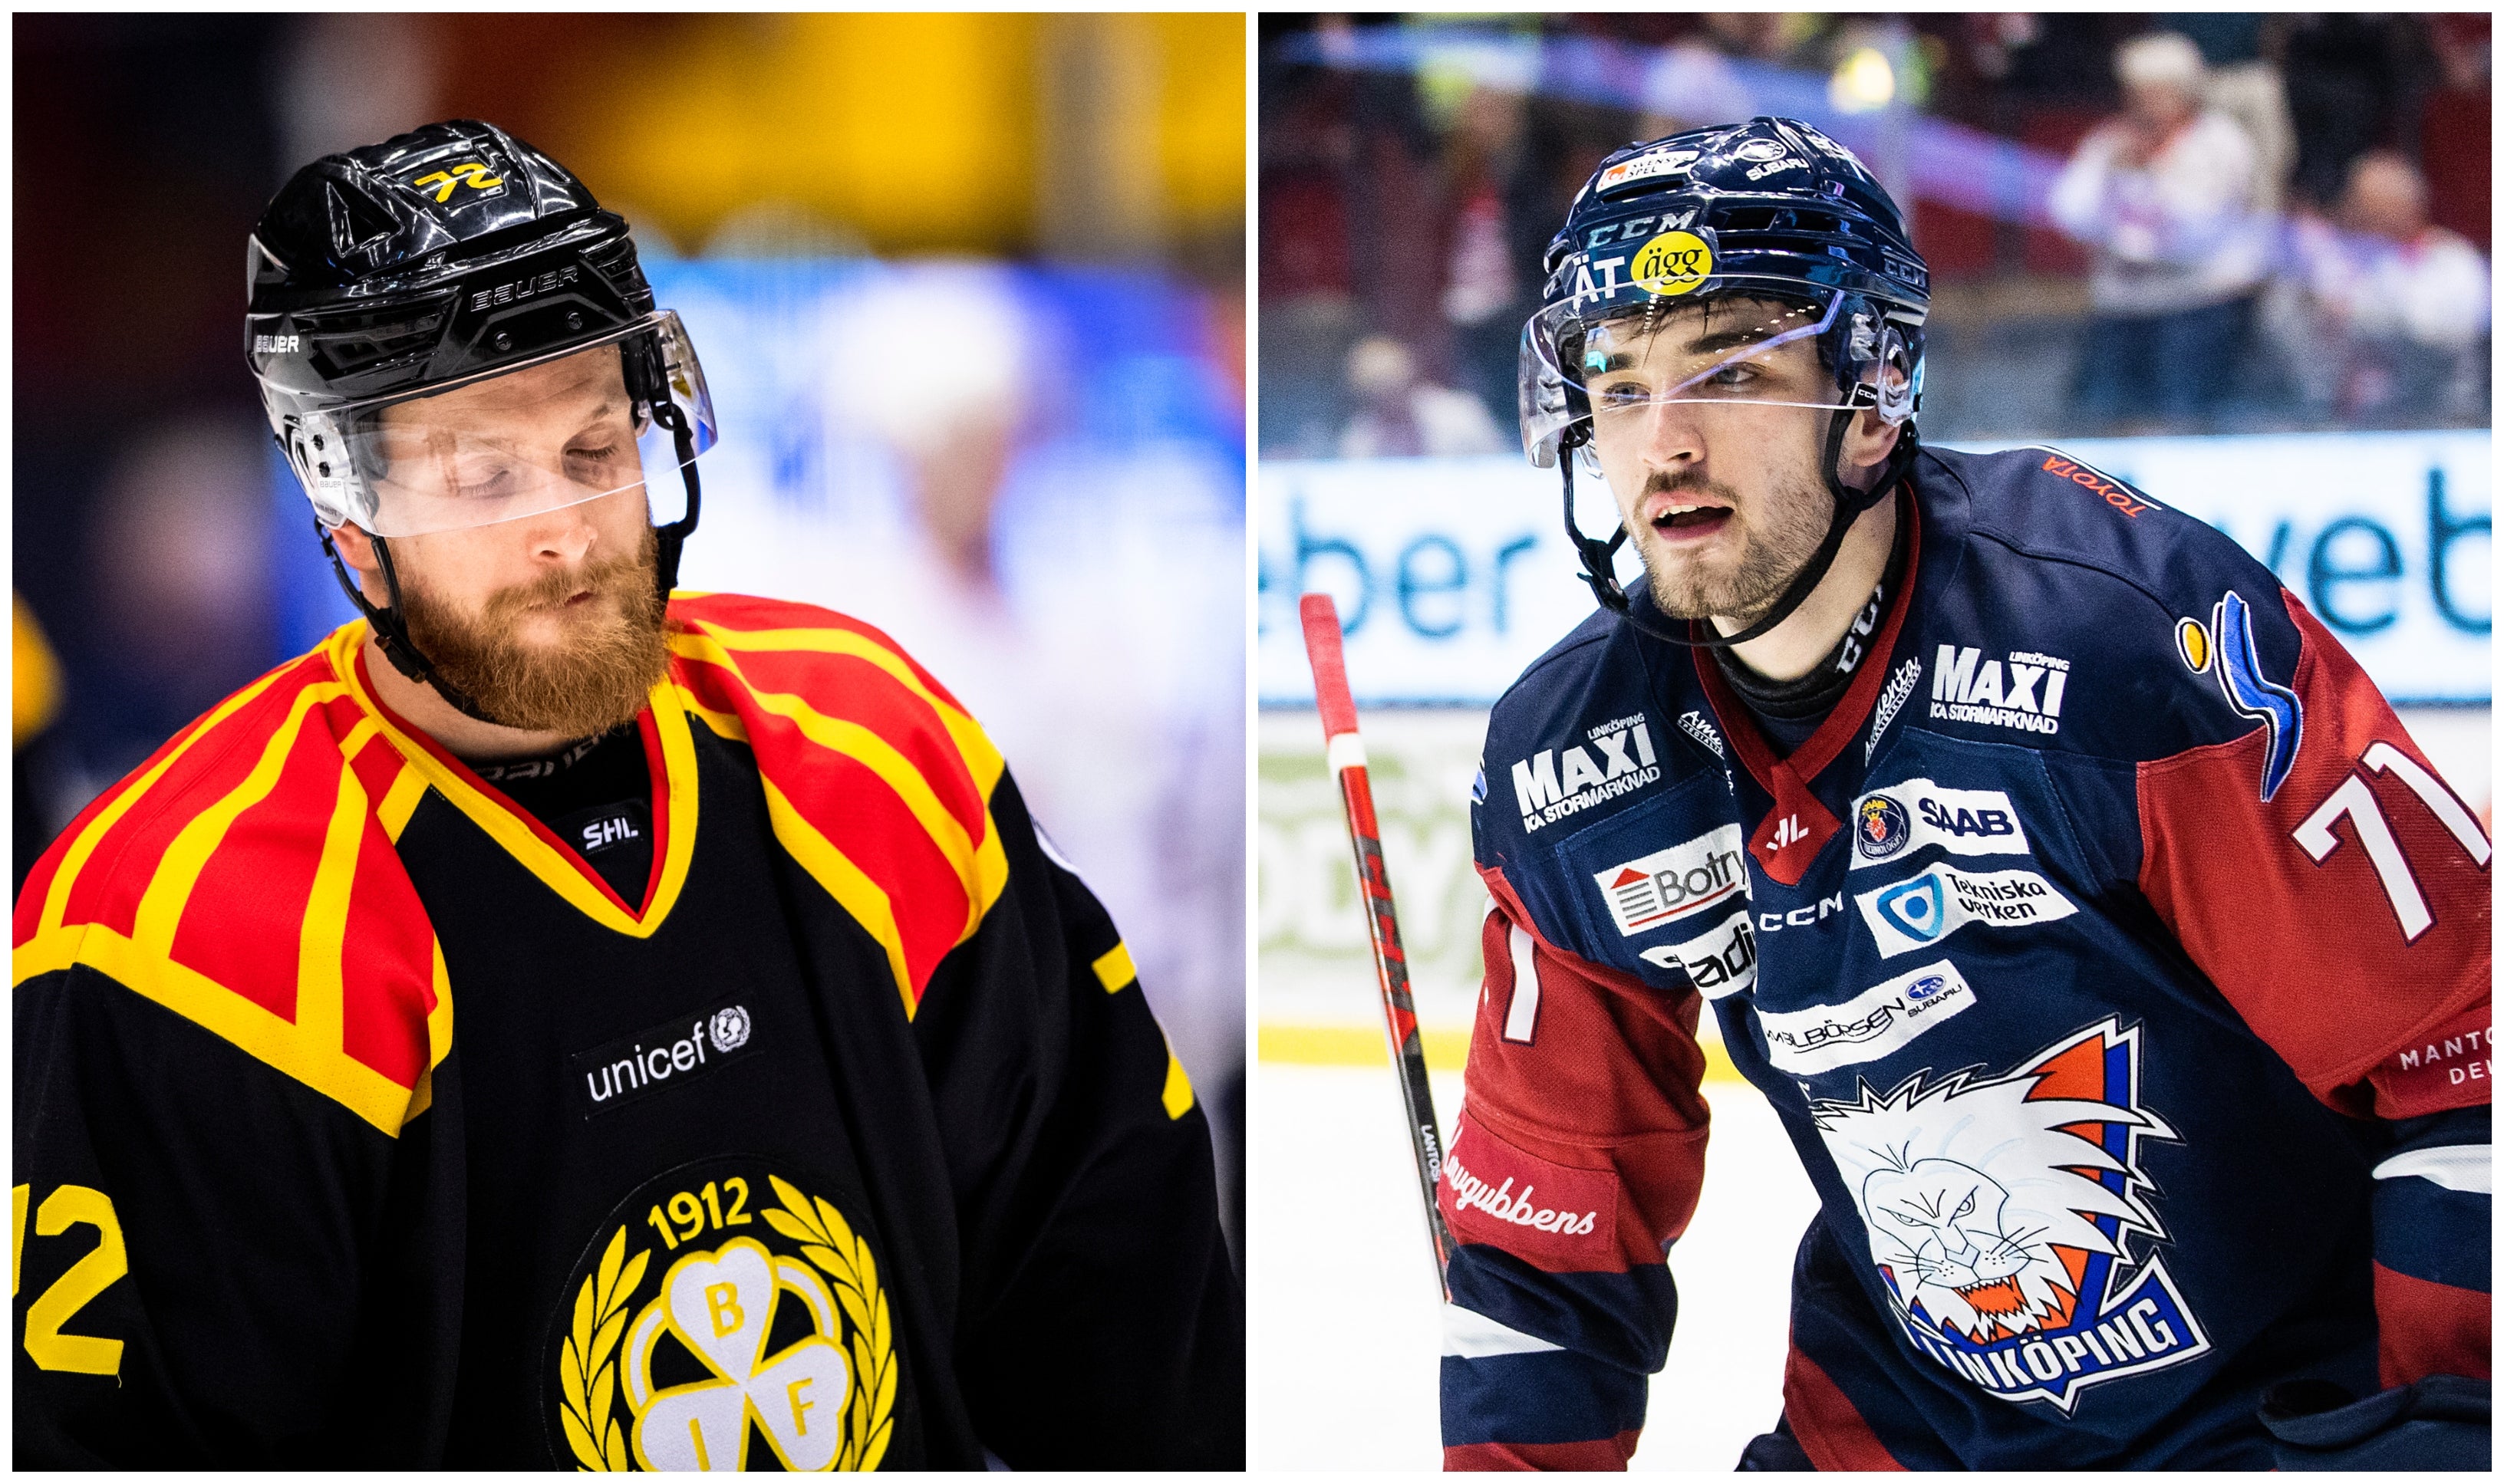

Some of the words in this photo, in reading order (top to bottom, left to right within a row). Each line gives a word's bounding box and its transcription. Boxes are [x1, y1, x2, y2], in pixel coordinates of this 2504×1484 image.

[413, 163, 504, 203] 72
[1628, 166, 1659, 178] SPEL
[1746, 158, 1810, 181] SUBARU
[1587, 209, 1696, 250] CCM
[470, 265, 578, 312] BAUER
[1572, 253, 1625, 307] ÄT
[1643, 247, 1703, 286] ägg
[1857, 388, 1878, 400] CCM
[2041, 456, 2147, 518] TOYOTA
[1932, 644, 2067, 717] MAXI
[2009, 651, 2071, 671] LINKÖPING
[1586, 712, 1646, 741] LINKÖPING
[1929, 702, 1949, 720] ICA
[1949, 705, 2059, 735] STORMARKNAD
[1511, 722, 1657, 817] MAXI
[1523, 812, 1547, 834] ICA
[1544, 766, 1662, 823] STORMARKNAD
[1919, 798, 2015, 837] SAAB
[583, 817, 638, 850] SHL
[2288, 739, 2492, 947] 71
[1946, 873, 2048, 901] Tekniska
[1759, 890, 1844, 932] CCM
[1959, 898, 2038, 920] verken
[1908, 984, 1962, 1018] SUBARU
[587, 1021, 706, 1101] unicef
[647, 1176, 753, 1251] 1912
[705, 1282, 746, 1339] B
[786, 1377, 815, 1437] F
